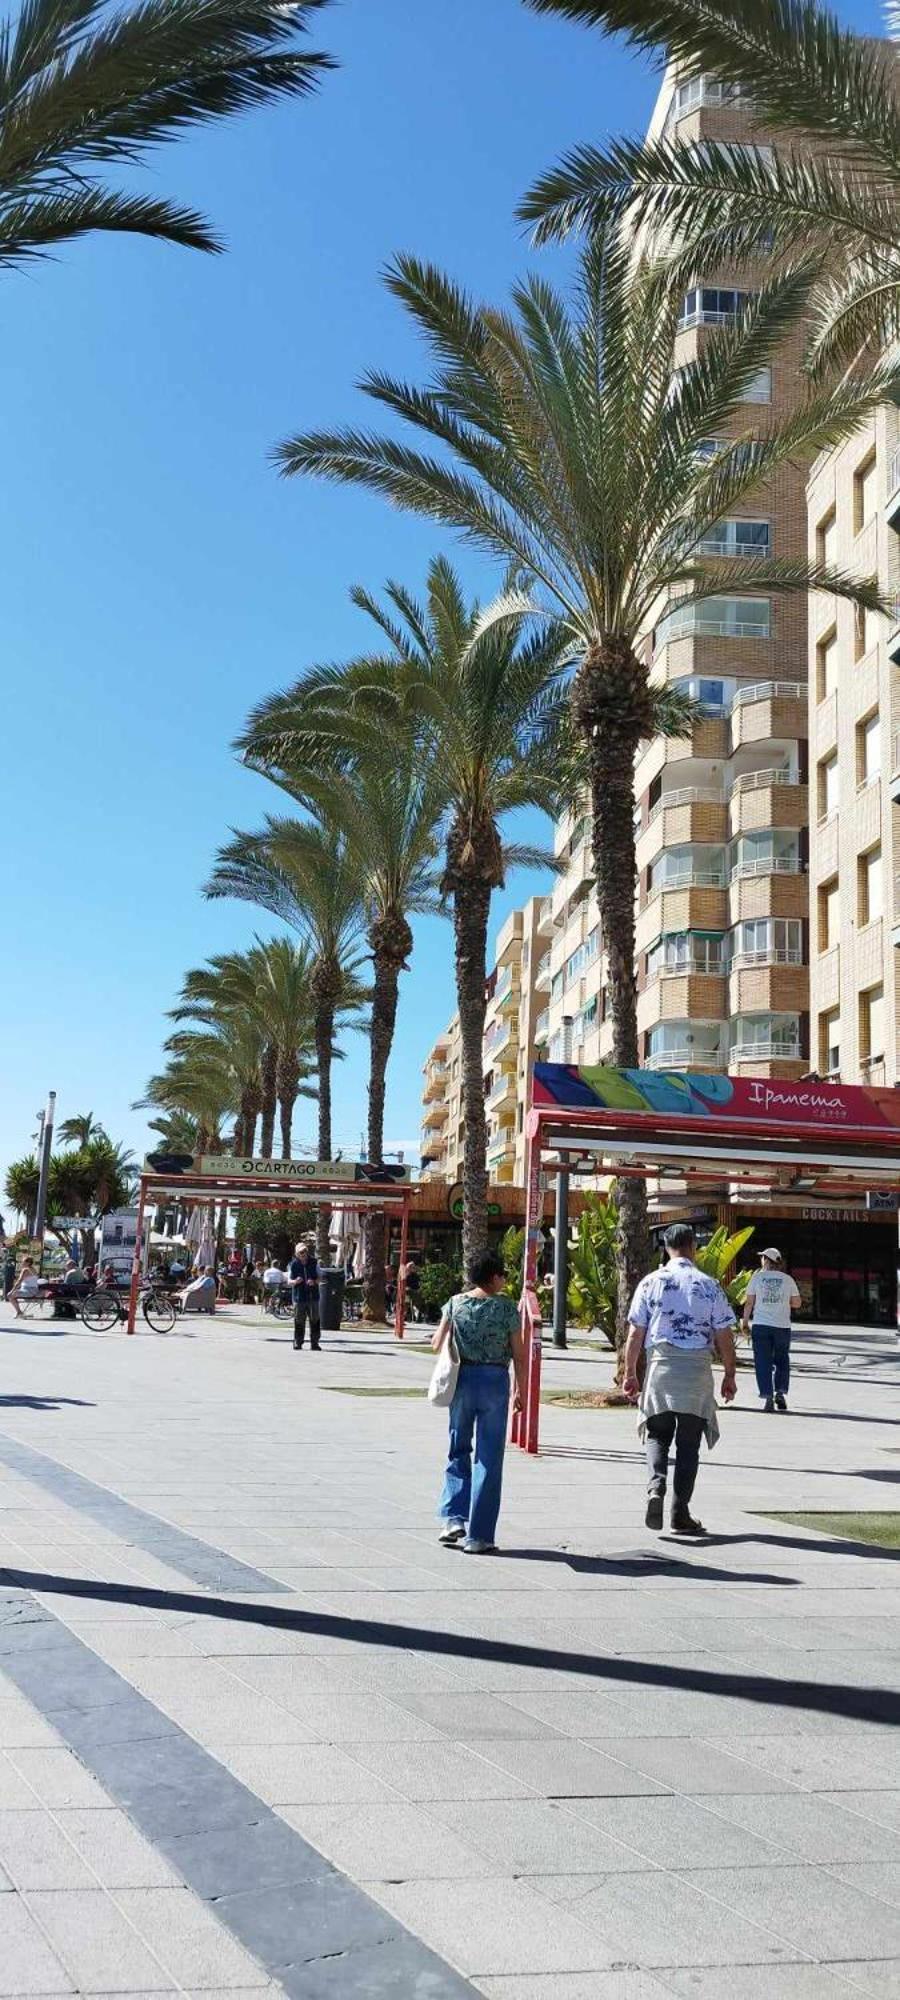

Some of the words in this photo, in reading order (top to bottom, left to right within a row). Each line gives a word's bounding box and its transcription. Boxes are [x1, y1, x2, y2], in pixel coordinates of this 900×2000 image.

[748, 1082, 846, 1111] Ipanema
[255, 1162, 316, 1175] CARTAGO
[802, 1208, 869, 1222] COCKTAILS
